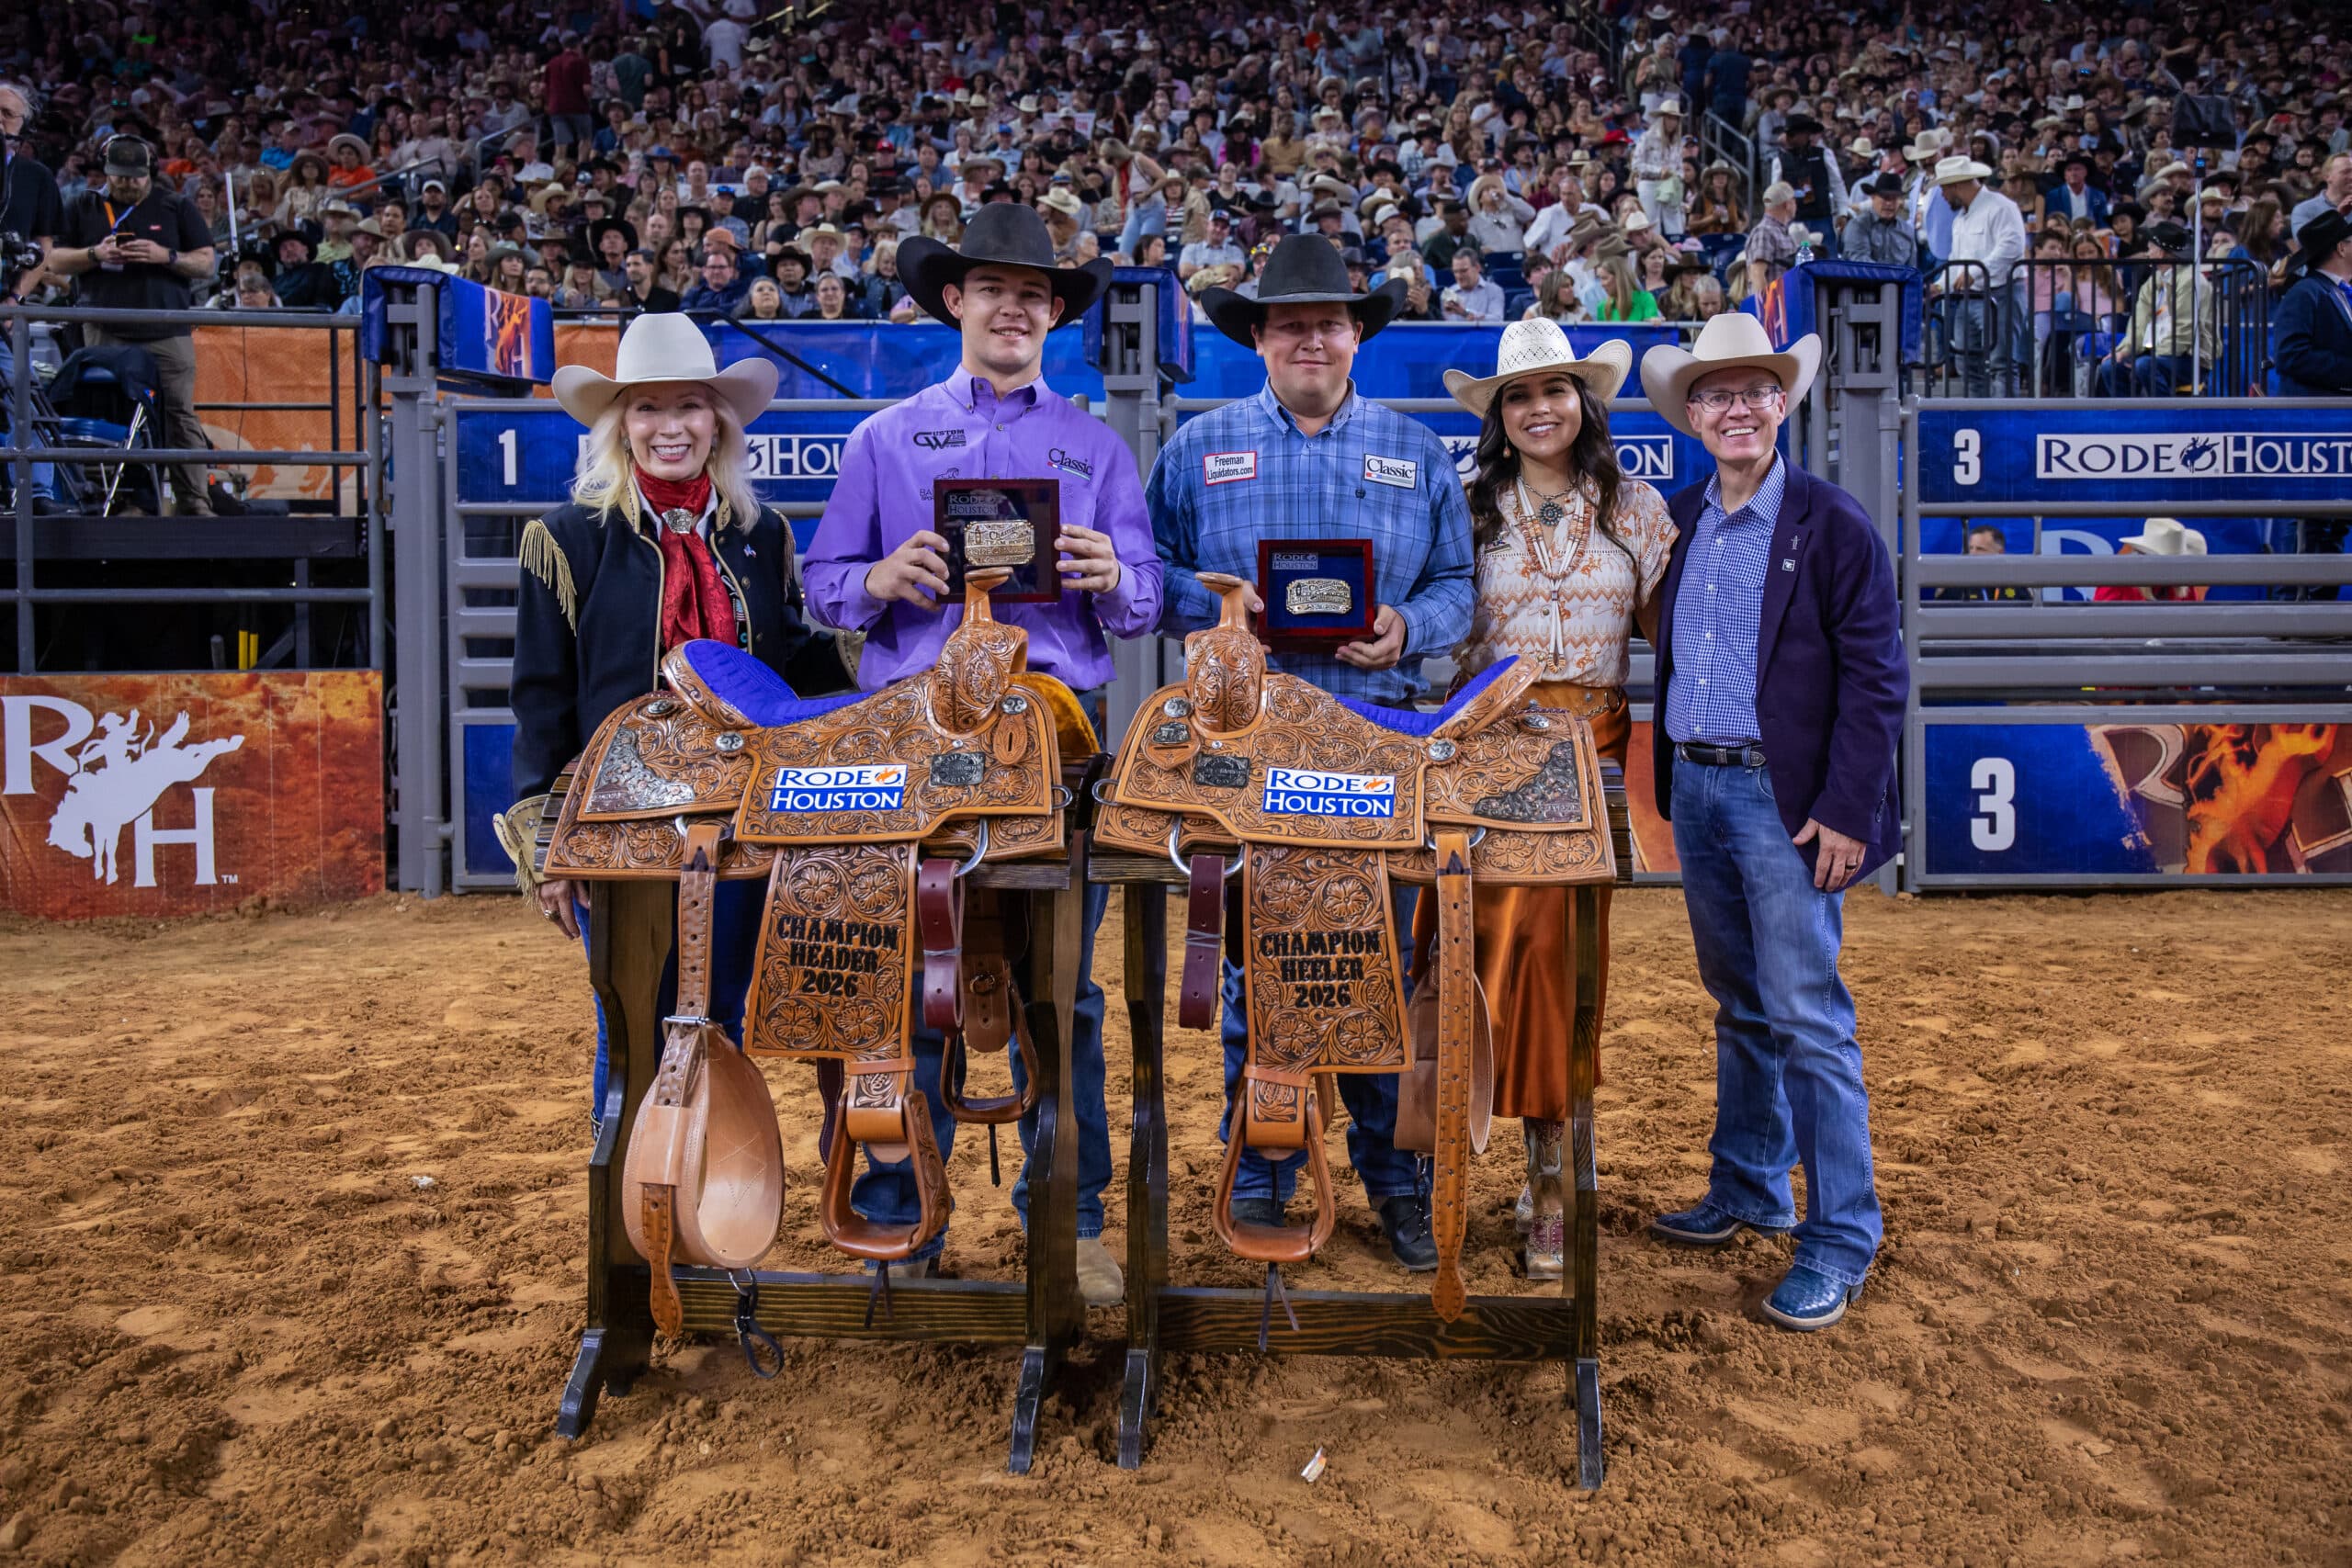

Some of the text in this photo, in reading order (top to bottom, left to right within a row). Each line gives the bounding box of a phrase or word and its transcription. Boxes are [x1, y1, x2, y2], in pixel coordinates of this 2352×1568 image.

[498, 429, 516, 486] 1
[1048, 447, 1094, 476] Classic
[1215, 456, 1245, 467] Freeman
[1613, 444, 1669, 475] ON
[1954, 429, 1981, 485] 3
[2043, 436, 2352, 474] RODEO HOUST
[1206, 467, 1253, 480] Liquidators.com
[1367, 458, 1413, 479] Classic
[949, 494, 995, 504] RODEO
[949, 505, 997, 514] HOUSTON
[1274, 552, 1317, 561] RODEO
[1, 695, 95, 795] R
[780, 769, 901, 786] RODEO
[1271, 770, 1390, 793] RODEO
[772, 790, 899, 810] HOUSTON
[1264, 792, 1390, 816] HOUSTON
[1971, 757, 2015, 851] 3
[777, 915, 899, 951] CHAMPION
[1260, 931, 1380, 957] CHAMPION
[790, 942, 878, 974] HEADER
[1281, 957, 1364, 983] HEELER
[802, 970, 859, 998] 2026
[1295, 983, 1351, 1008] 2026
